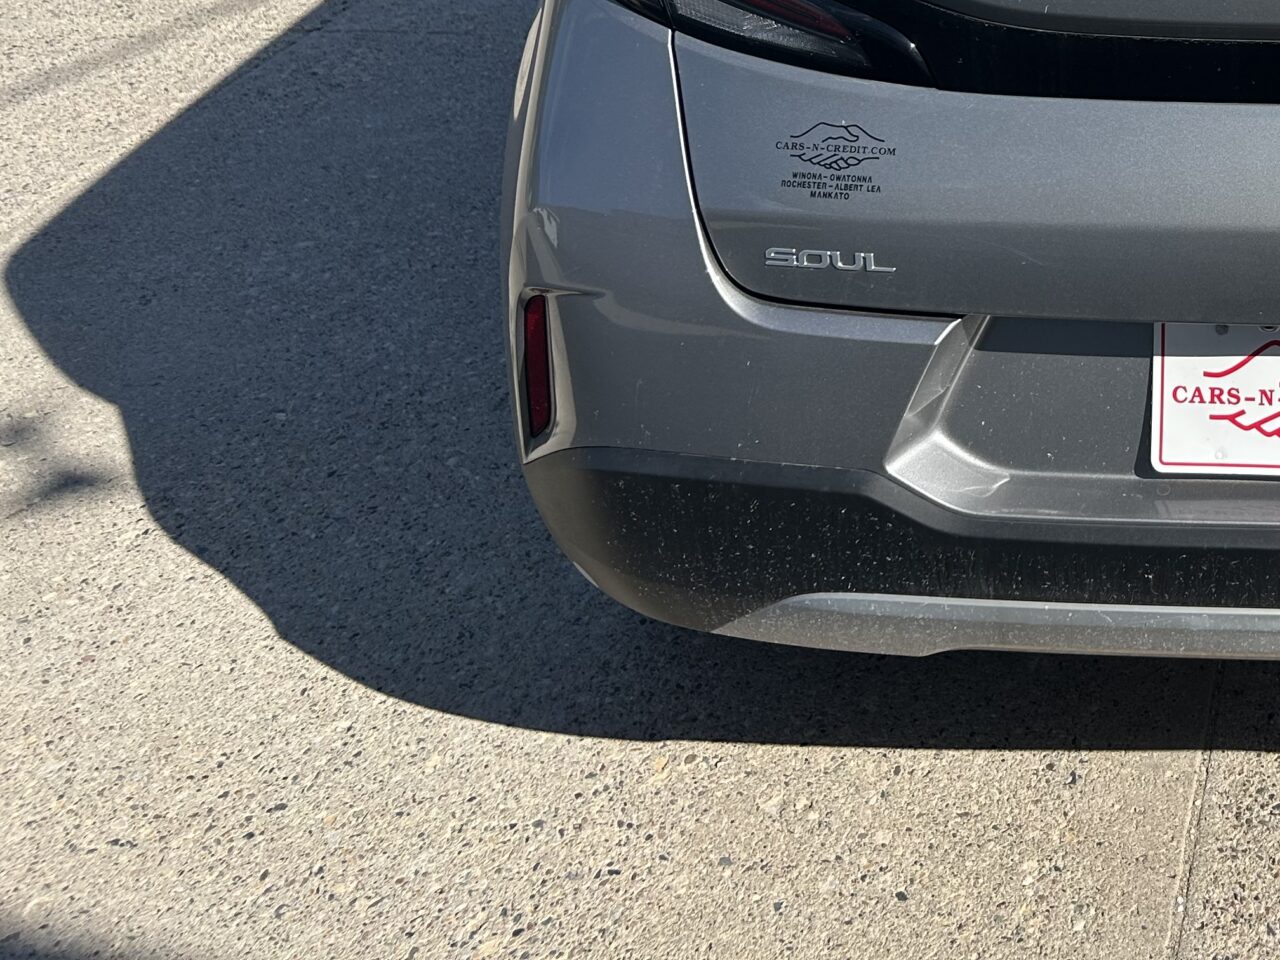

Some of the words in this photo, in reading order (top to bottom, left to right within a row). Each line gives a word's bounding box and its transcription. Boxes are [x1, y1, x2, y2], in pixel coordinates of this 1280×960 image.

[775, 140, 896, 156] CARS-N-CREDIT.COM
[809, 190, 850, 200] MANKATO
[866, 184, 881, 193] LEA
[765, 247, 897, 272] SOUL
